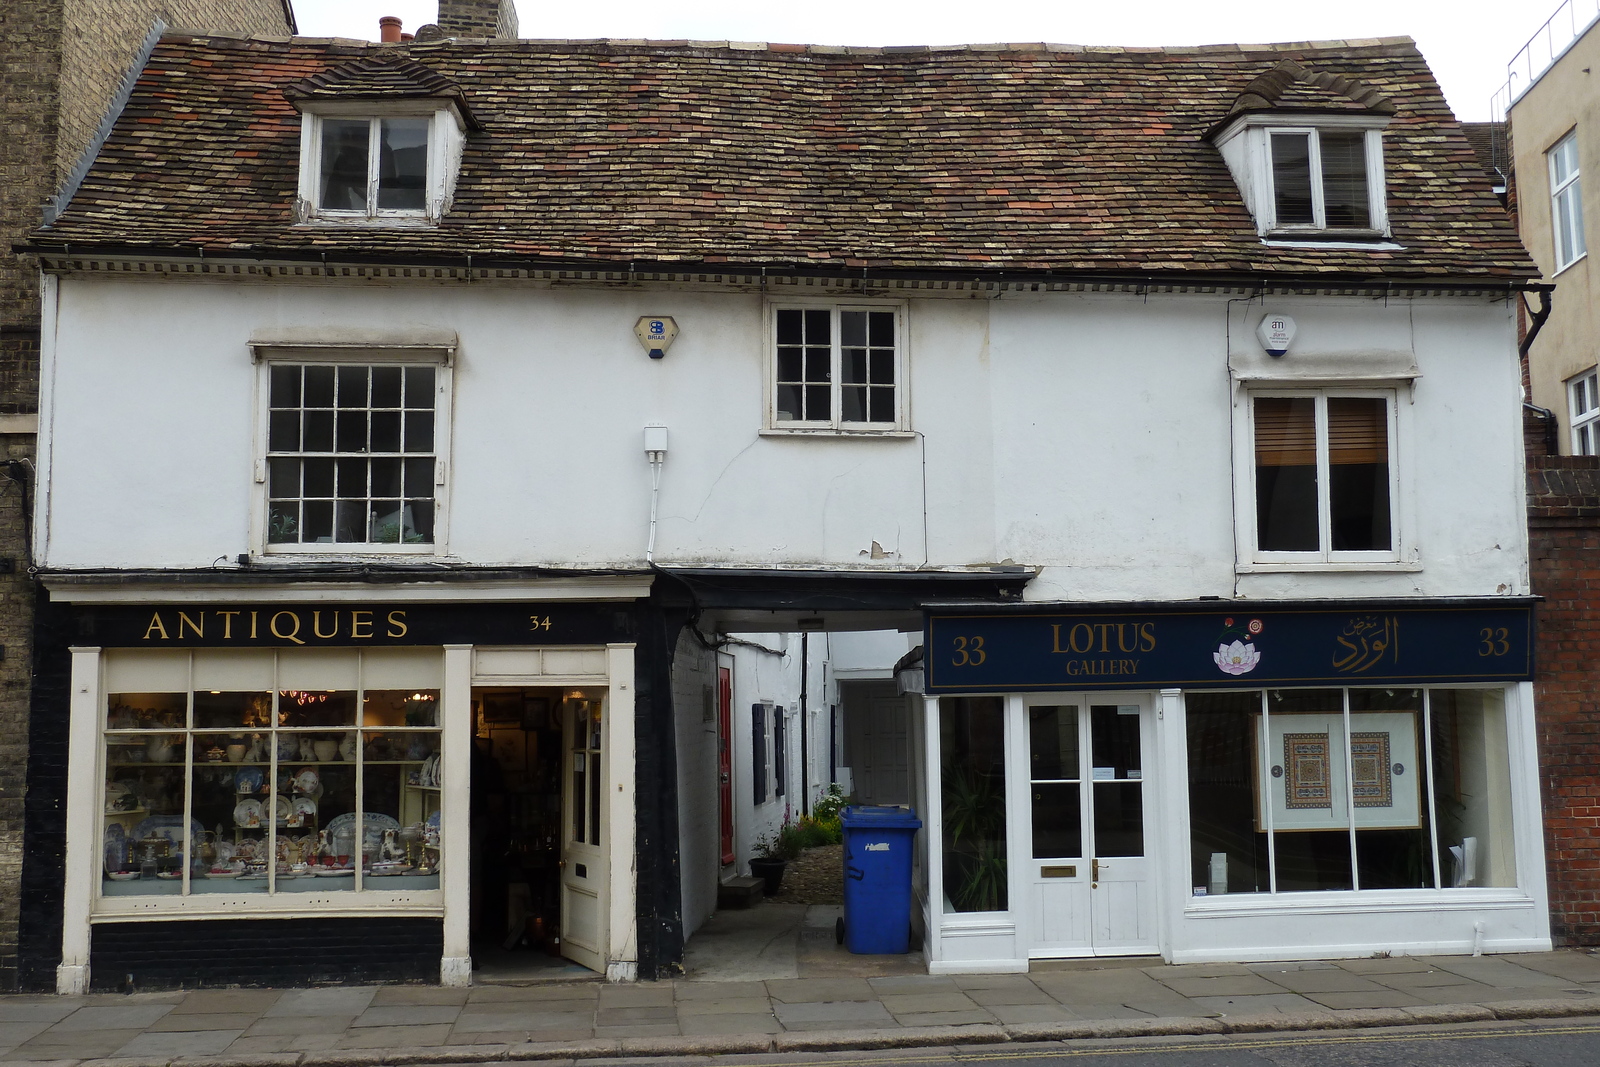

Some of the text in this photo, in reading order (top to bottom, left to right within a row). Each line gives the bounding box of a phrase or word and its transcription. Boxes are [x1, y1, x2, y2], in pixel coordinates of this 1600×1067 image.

[142, 610, 408, 645] ANTIQUES
[529, 615, 552, 631] 34
[1051, 622, 1157, 654] LOTUS
[951, 636, 987, 667] 33
[1478, 627, 1510, 657] 33
[1065, 658, 1141, 677] GALLERY
